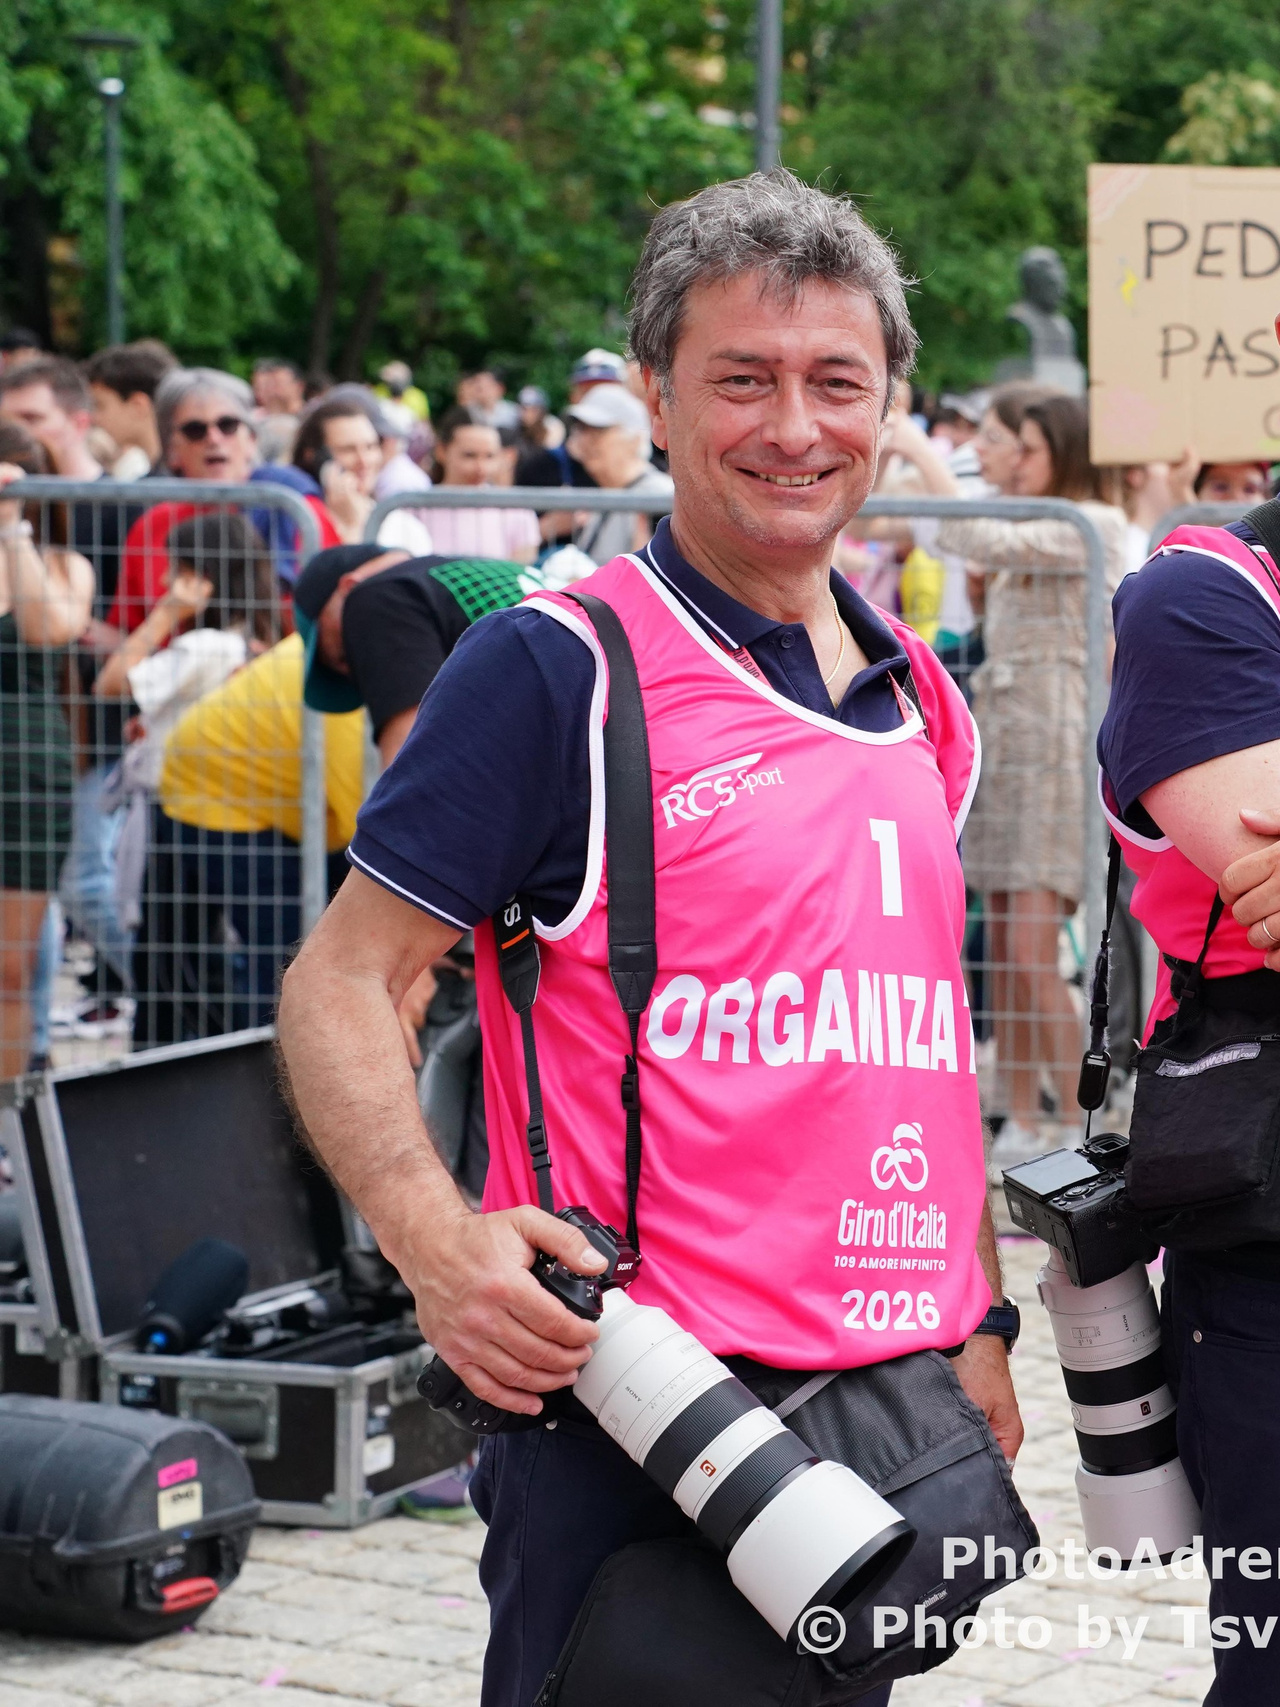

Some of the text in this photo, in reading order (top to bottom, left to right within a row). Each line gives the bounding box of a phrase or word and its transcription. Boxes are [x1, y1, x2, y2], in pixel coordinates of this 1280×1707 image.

[1159, 323, 1280, 381] PAS
[660, 766, 785, 830] RCS Sport
[868, 817, 904, 917] 1
[837, 1198, 947, 1250] Giro d'Italia
[616, 1262, 634, 1272] SONY
[834, 1255, 946, 1271] 109 AMORE INFINITO
[841, 1289, 941, 1331] 2026
[625, 1385, 642, 1402] SONY
